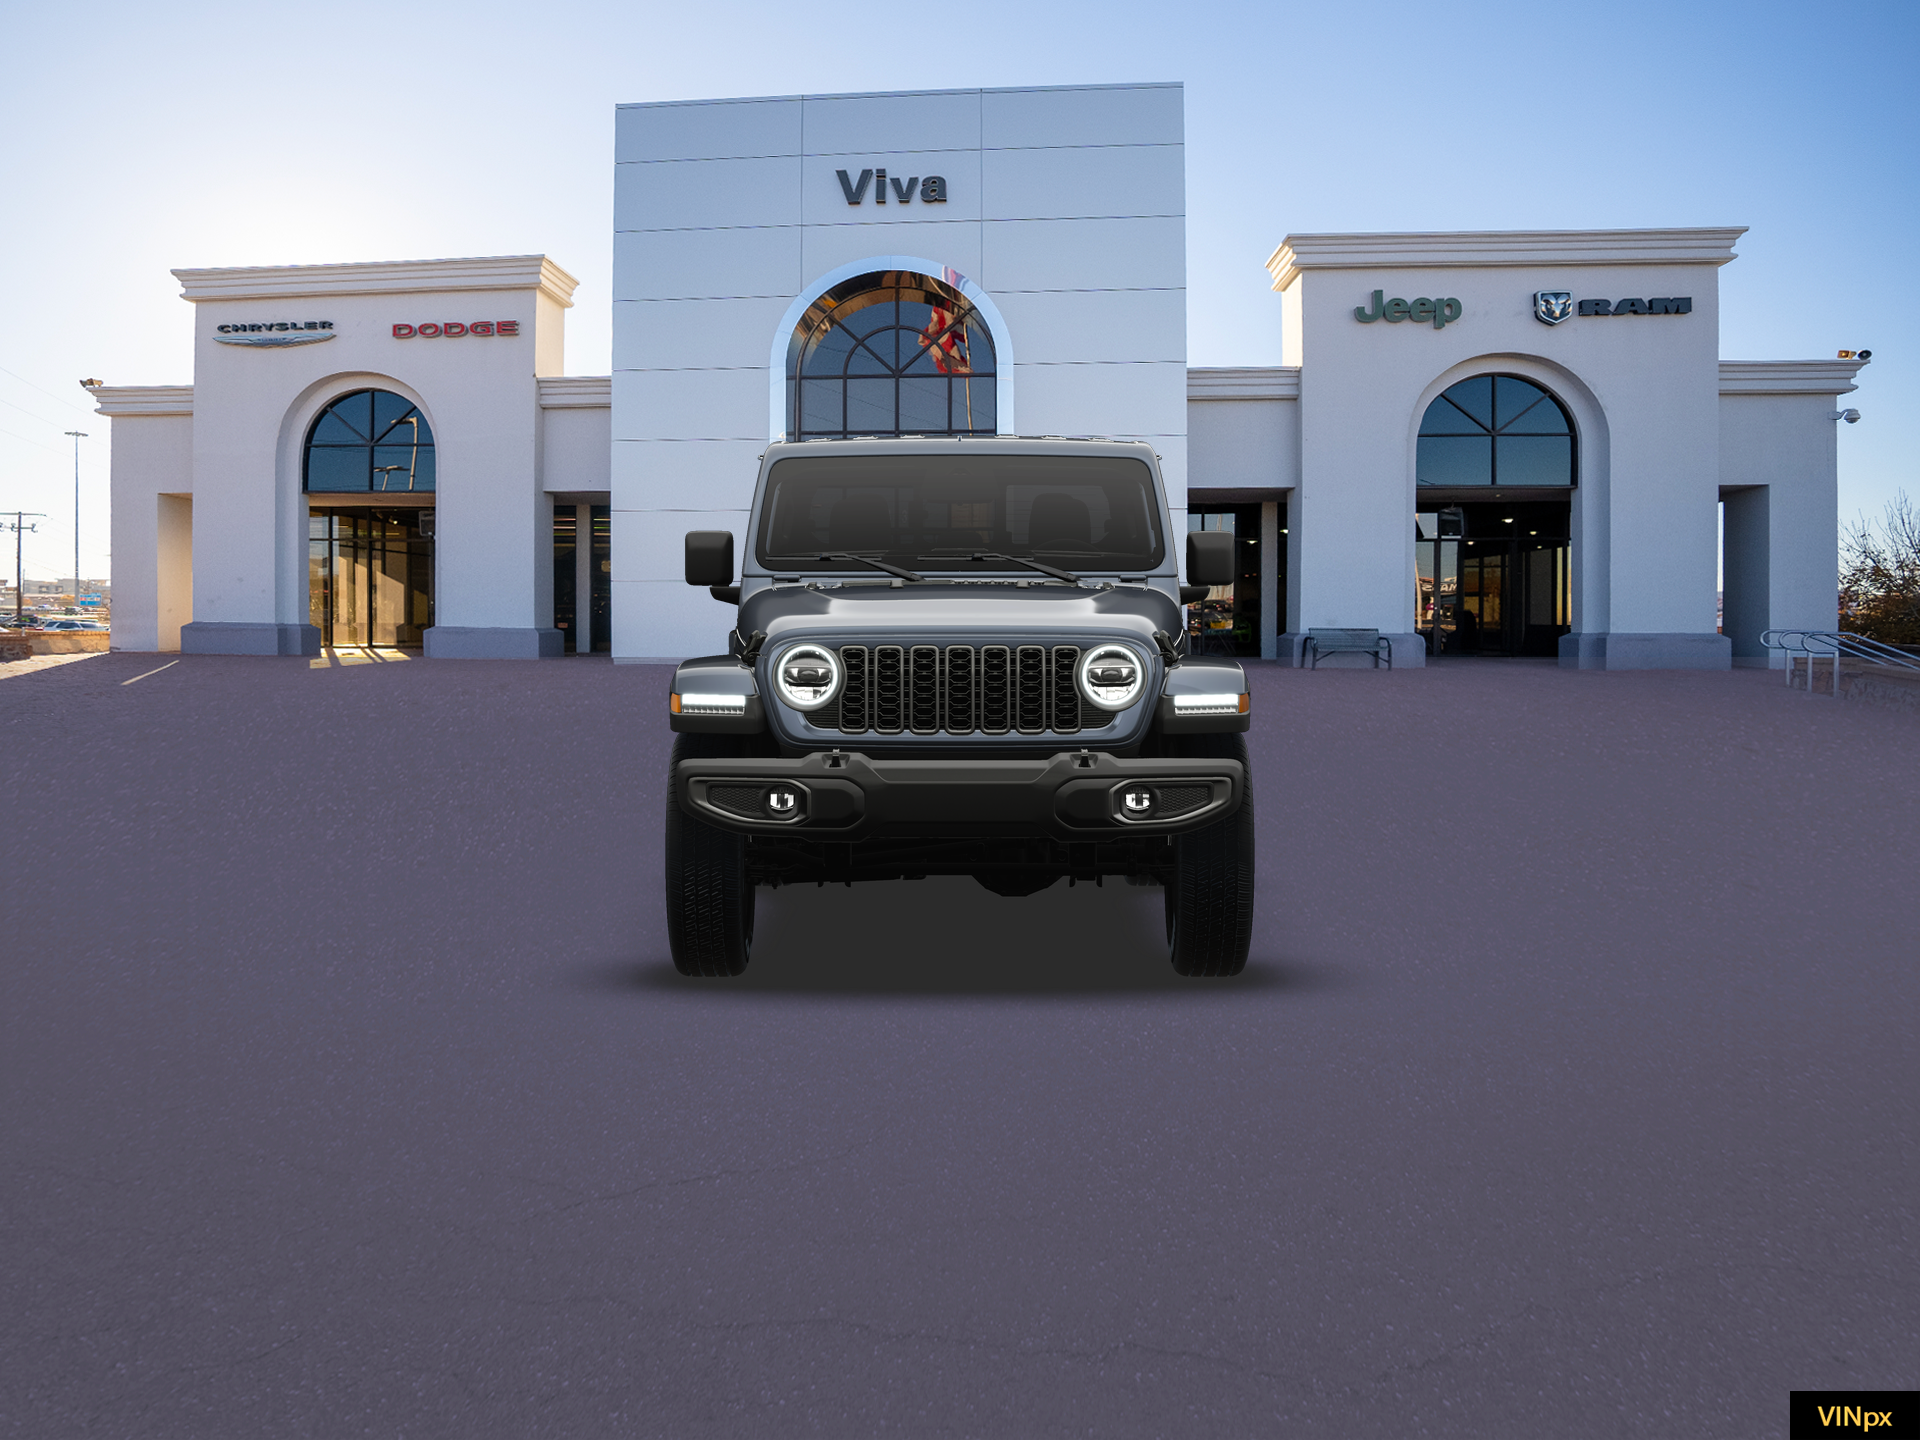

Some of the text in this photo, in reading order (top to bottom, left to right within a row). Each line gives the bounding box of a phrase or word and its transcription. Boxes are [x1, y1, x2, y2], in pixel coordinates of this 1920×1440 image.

[835, 168, 947, 205] Viva
[1354, 289, 1463, 329] Jeep
[1579, 297, 1692, 316] RAM
[217, 320, 334, 334] CHRYSLER
[392, 320, 520, 339] DODGE
